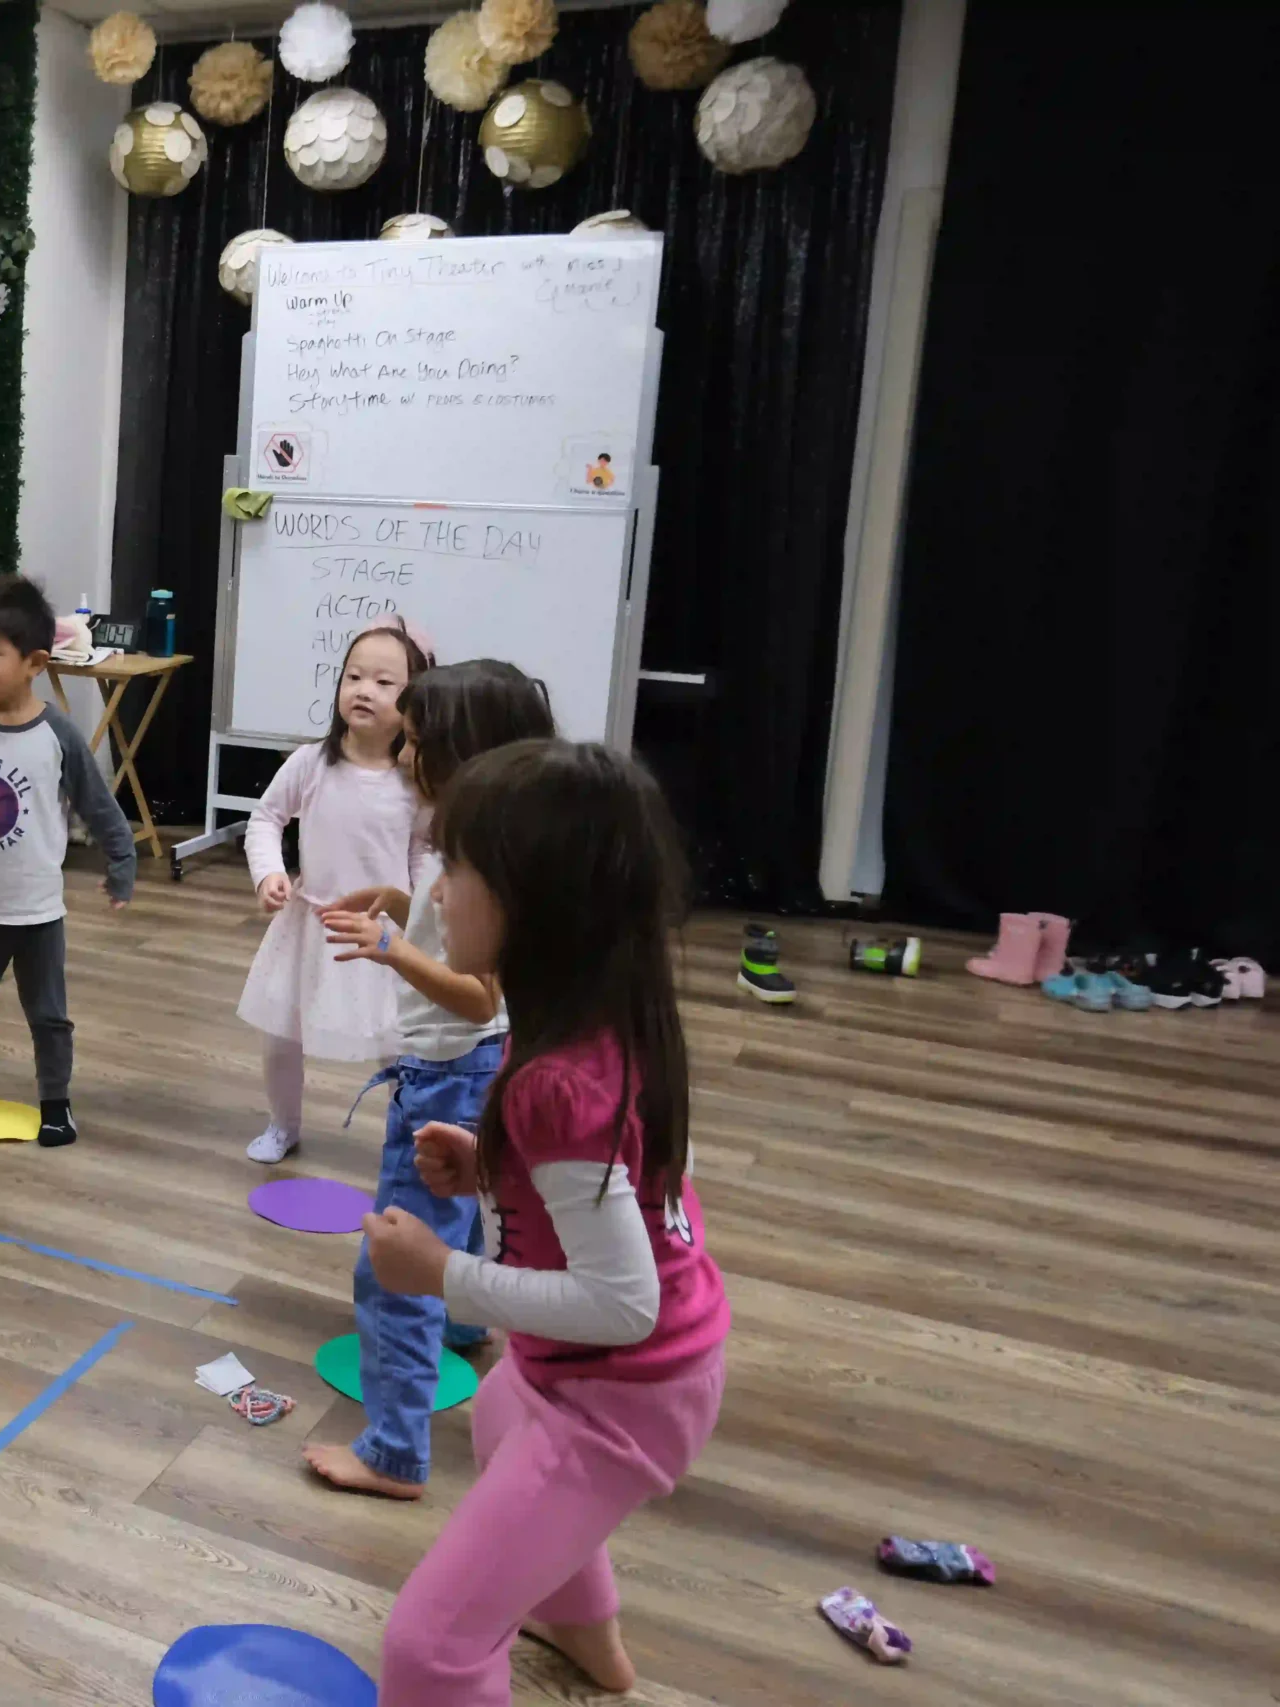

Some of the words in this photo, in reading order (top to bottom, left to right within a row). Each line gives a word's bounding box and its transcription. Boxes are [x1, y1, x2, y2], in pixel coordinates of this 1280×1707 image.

[365, 257, 413, 289] Tiny
[375, 329, 399, 348] On
[404, 327, 456, 353] Stage
[287, 362, 320, 389] Hey
[330, 360, 372, 380] What
[417, 361, 450, 382] You
[457, 354, 521, 382] Doing?
[288, 390, 391, 416] Storytime
[275, 511, 361, 542] WORDS
[376, 517, 410, 543] OF
[419, 521, 467, 552] THE
[483, 525, 542, 559] DAY
[311, 556, 414, 586] STAGE
[7, 767, 31, 798] LIL
